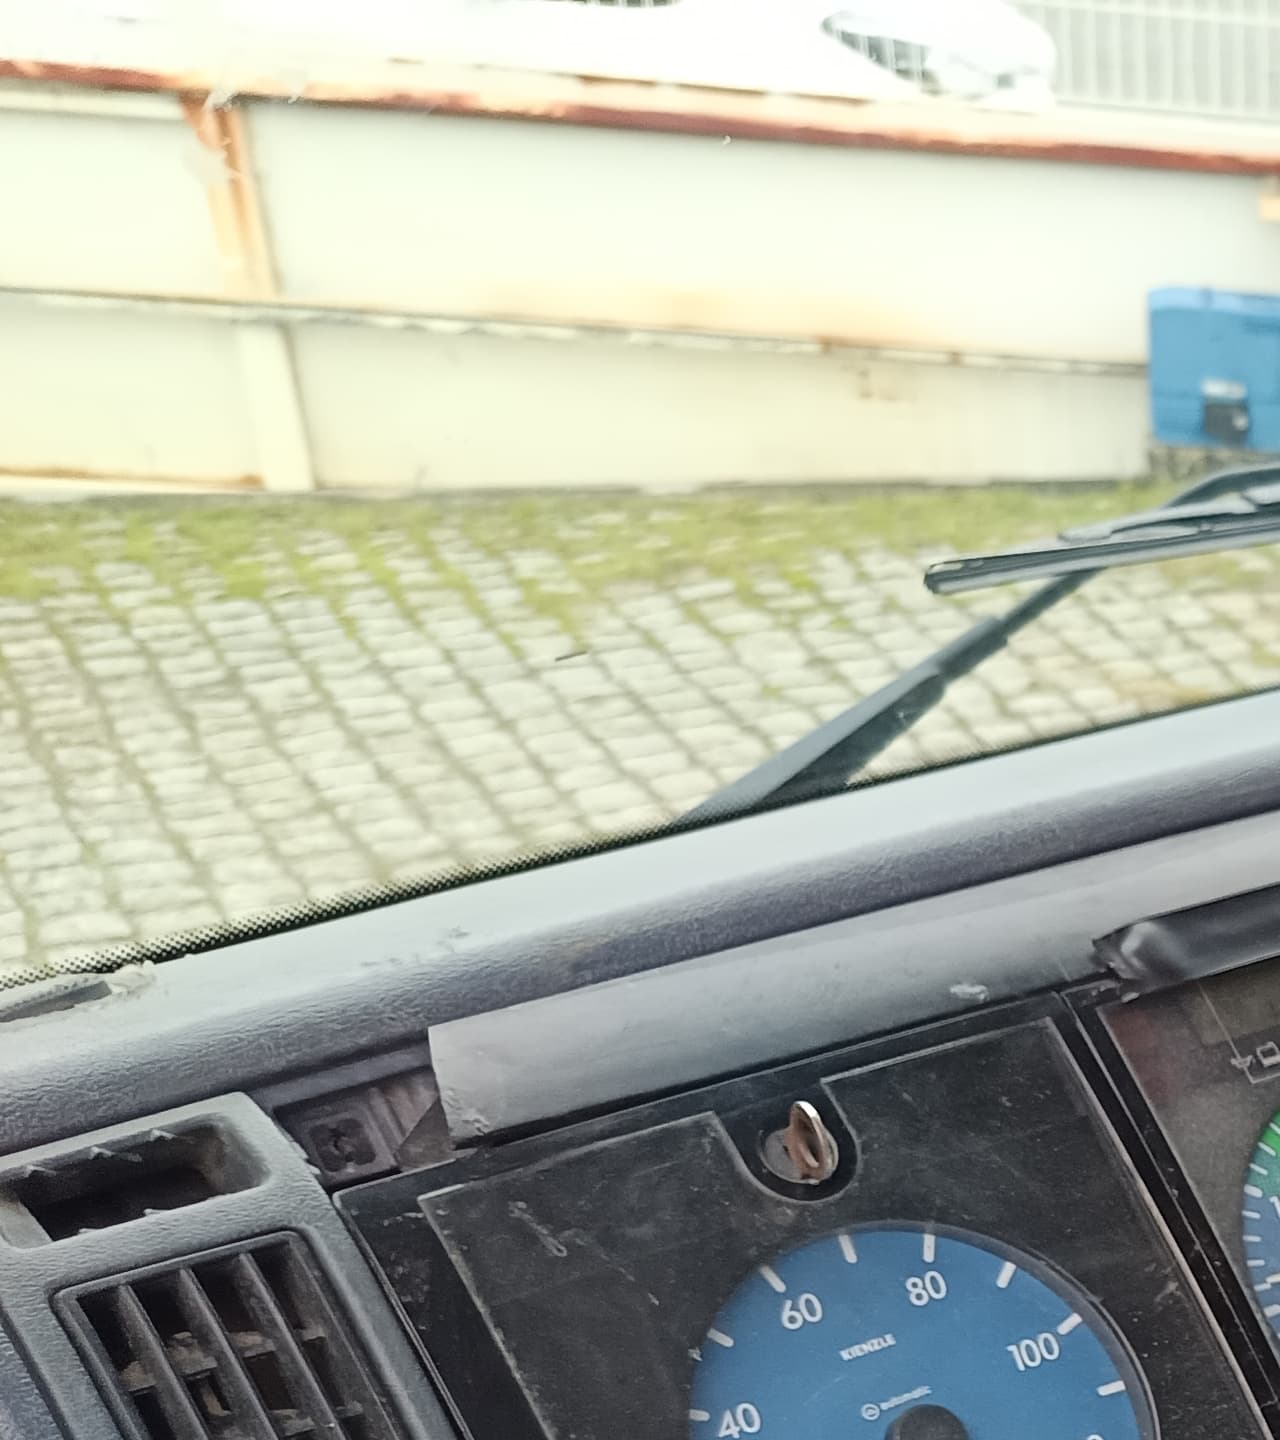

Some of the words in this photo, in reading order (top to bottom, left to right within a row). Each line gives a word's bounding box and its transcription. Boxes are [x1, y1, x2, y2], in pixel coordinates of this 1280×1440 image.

[905, 1270, 948, 1307] 80
[781, 1293, 823, 1331] 60
[839, 1333, 897, 1361] KIENZLE
[1006, 1332, 1061, 1372] 100
[718, 1402, 761, 1440] 40
